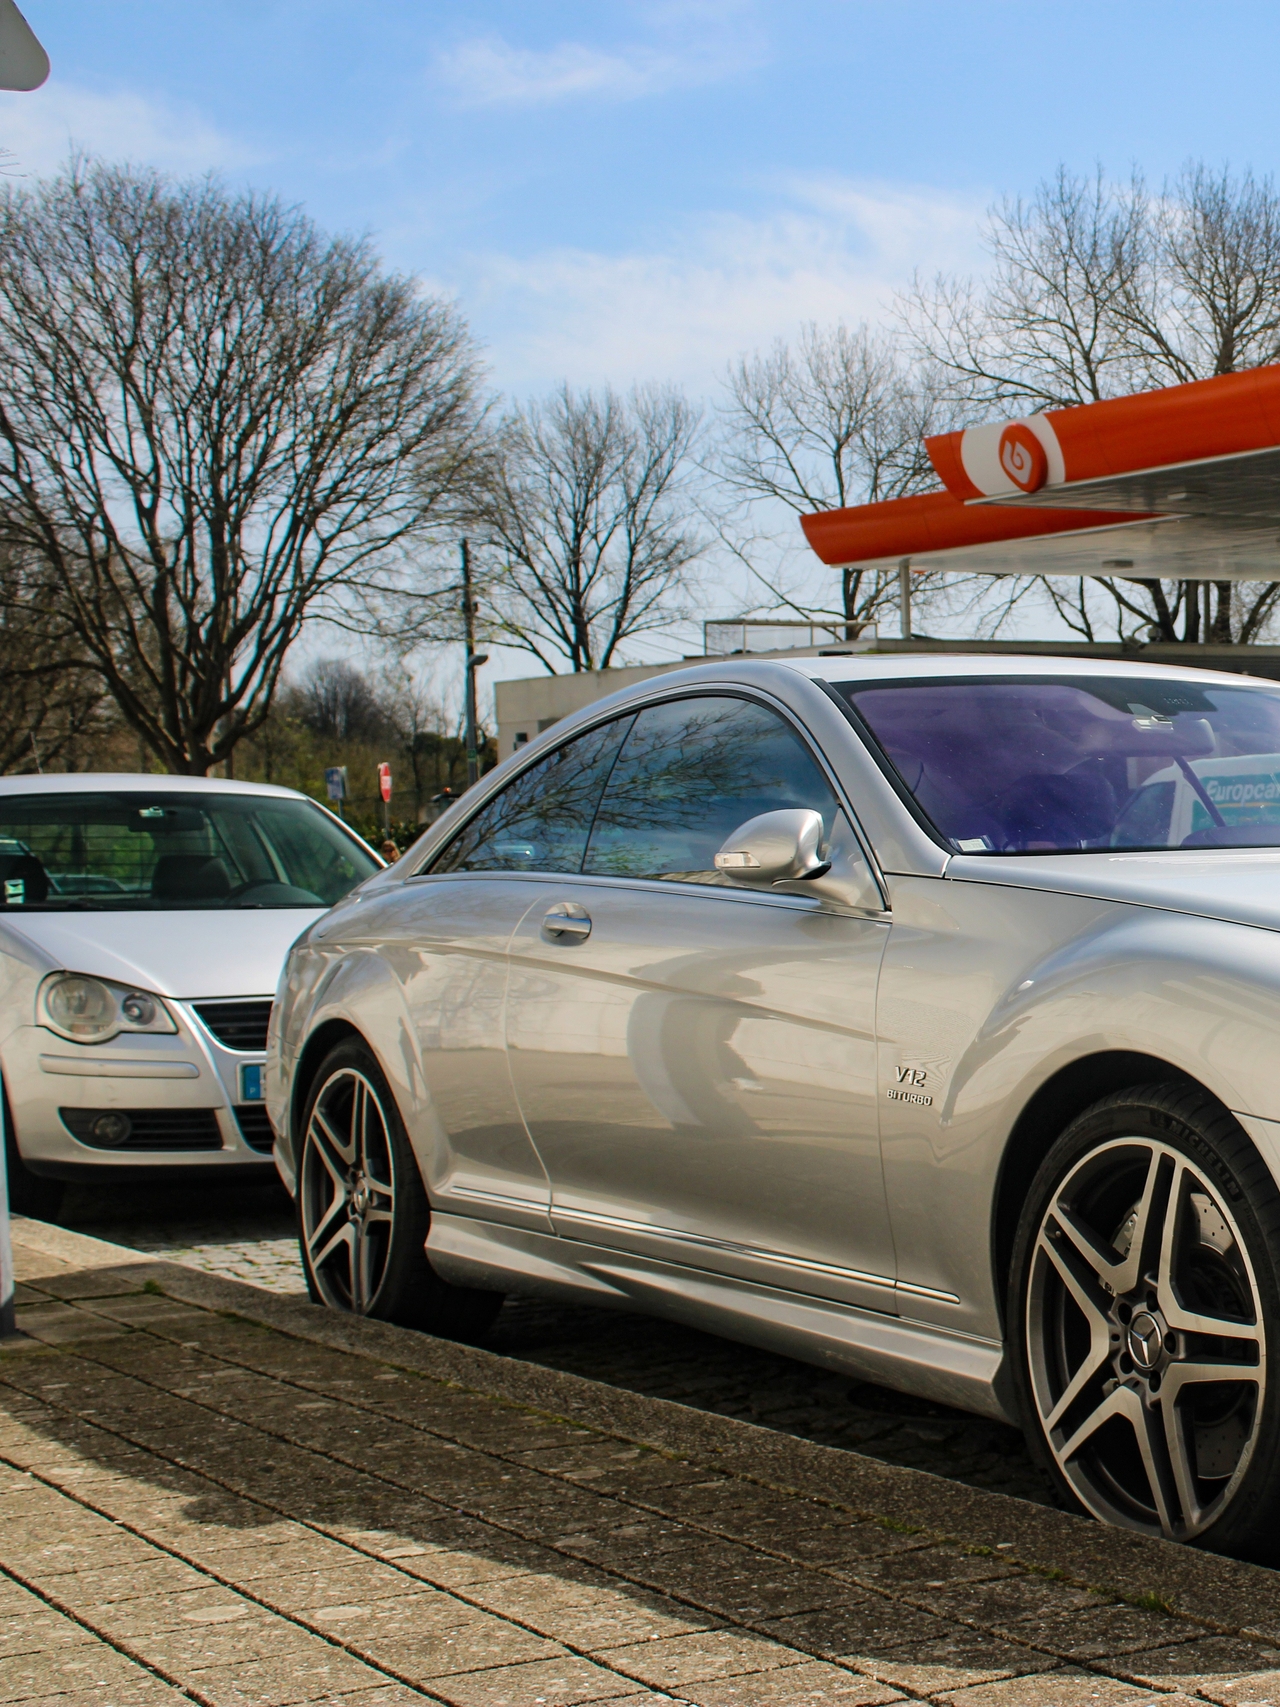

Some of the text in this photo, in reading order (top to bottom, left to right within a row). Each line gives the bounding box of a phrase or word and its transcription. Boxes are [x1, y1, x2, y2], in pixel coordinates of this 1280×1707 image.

[895, 1065, 926, 1087] V12
[887, 1089, 932, 1106] BITURBO
[1168, 1120, 1239, 1196] MICHELIN
